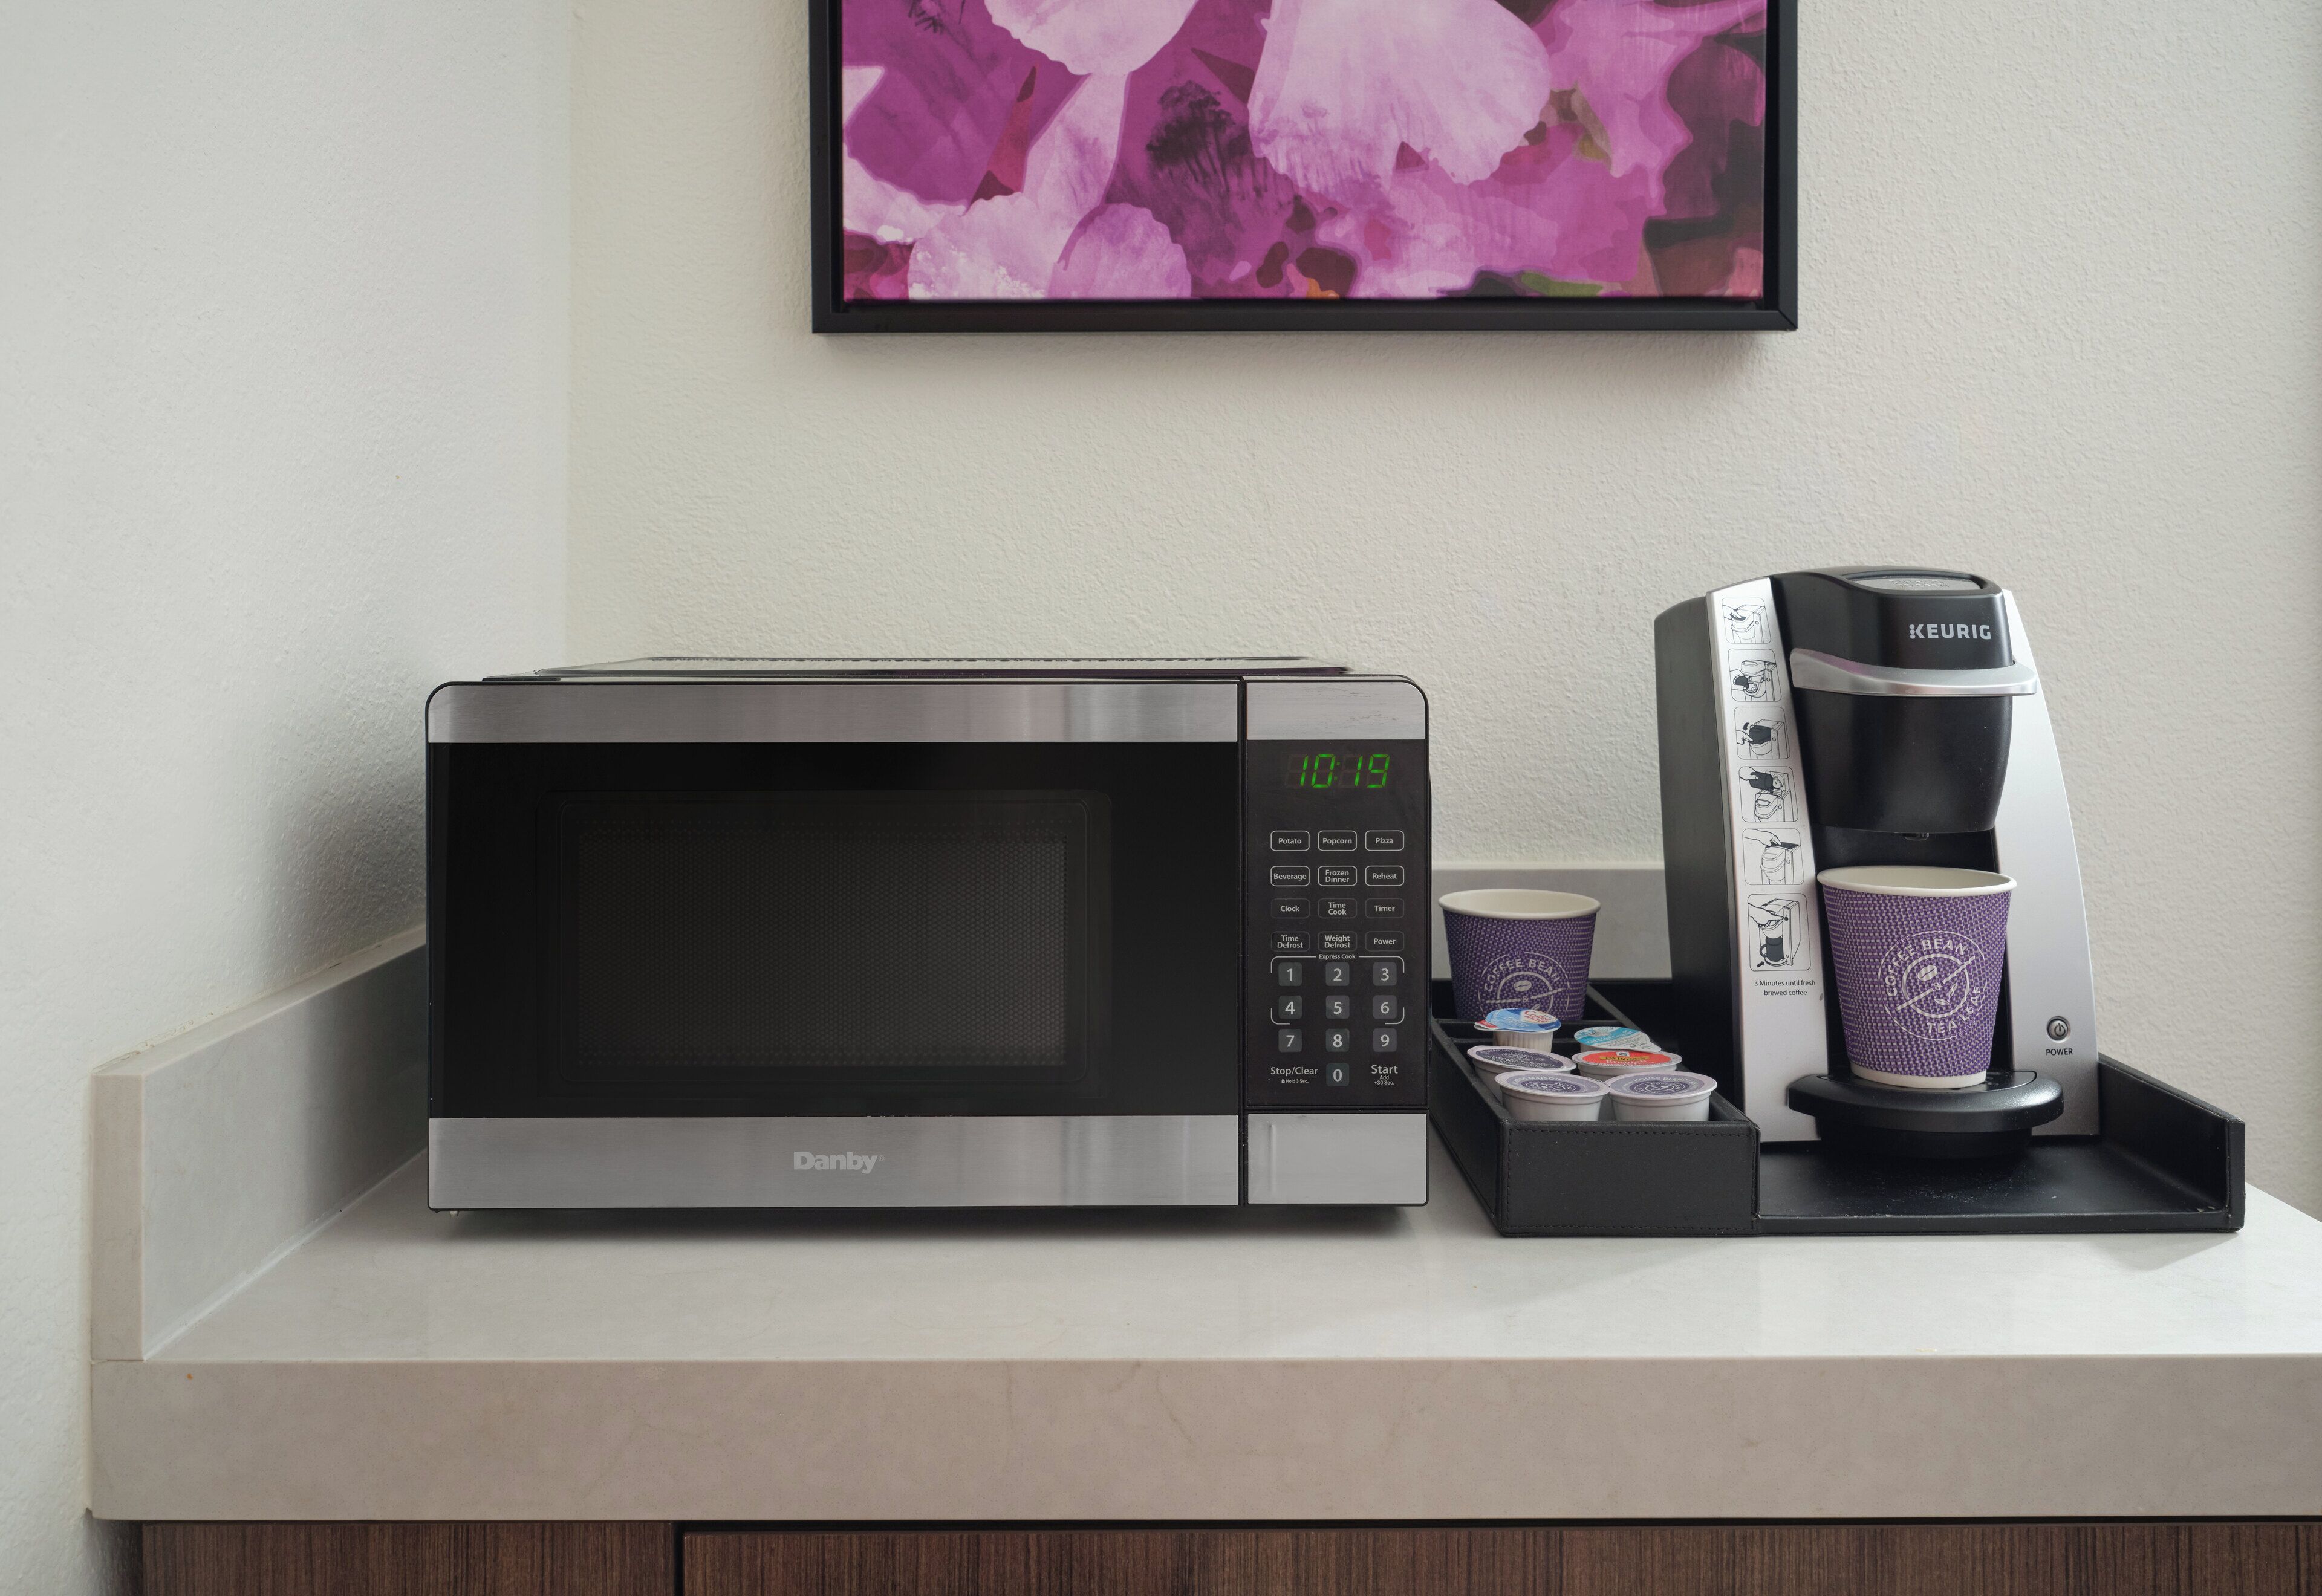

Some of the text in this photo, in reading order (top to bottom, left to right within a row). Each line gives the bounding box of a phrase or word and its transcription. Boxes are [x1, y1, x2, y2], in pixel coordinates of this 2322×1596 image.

[1909, 624, 1991, 640] KEURIG
[1300, 754, 1390, 788] 10:19
[1322, 837, 1352, 846] Popcorn
[1273, 873, 1307, 881] Beverage
[1885, 938, 1968, 997] COFFEE BEAN
[1287, 968, 1293, 981] 1
[1333, 968, 1342, 981] 2
[1381, 968, 1389, 981] 3
[1484, 958, 1561, 992] COFFEE BEAN
[1933, 982, 1942, 991] &
[1285, 1001, 1295, 1015] 4
[1333, 1001, 1342, 1014] 5
[1380, 1002, 1390, 1014] 6
[1927, 1020, 1958, 1033] TEA
[1959, 987, 1980, 1022] LEAF
[1286, 1035, 1295, 1047] 7
[1333, 1034, 1342, 1048] 8
[1381, 1034, 1390, 1047] 9
[2046, 1048, 2073, 1056] POWER
[1270, 1066, 1318, 1076] Stop/Clear
[1333, 1069, 1342, 1082] 0
[1371, 1064, 1398, 1074] Start
